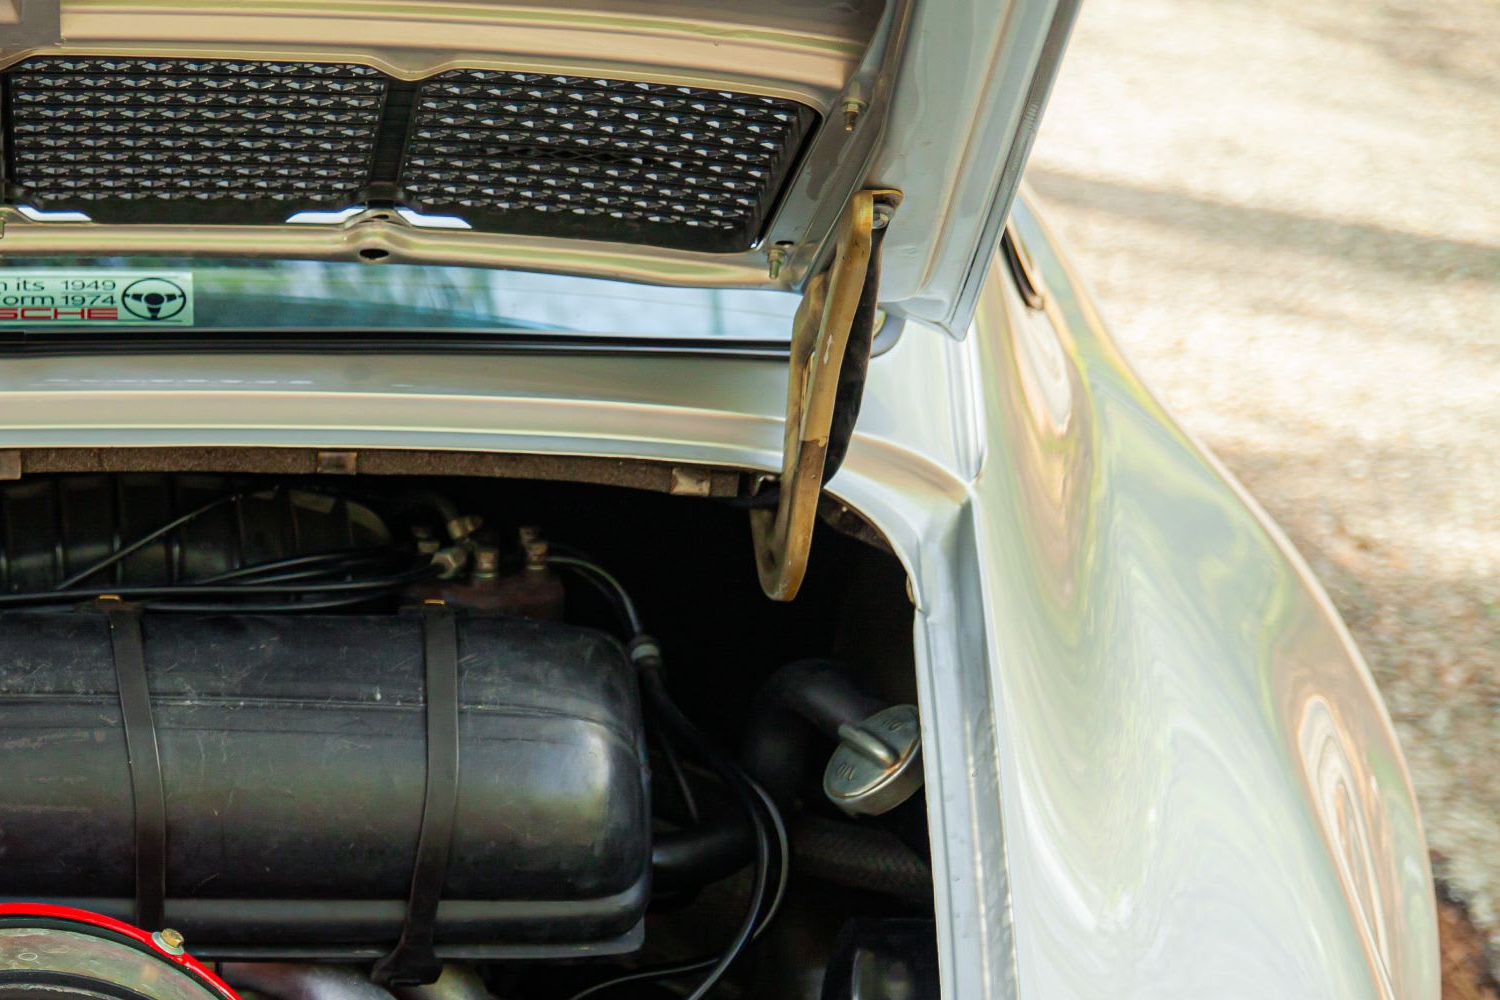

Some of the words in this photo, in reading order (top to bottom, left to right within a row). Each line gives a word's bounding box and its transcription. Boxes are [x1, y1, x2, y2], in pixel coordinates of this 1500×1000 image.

[16, 280, 46, 292] its
[60, 280, 117, 292] 1949
[61, 294, 116, 307] 1974
